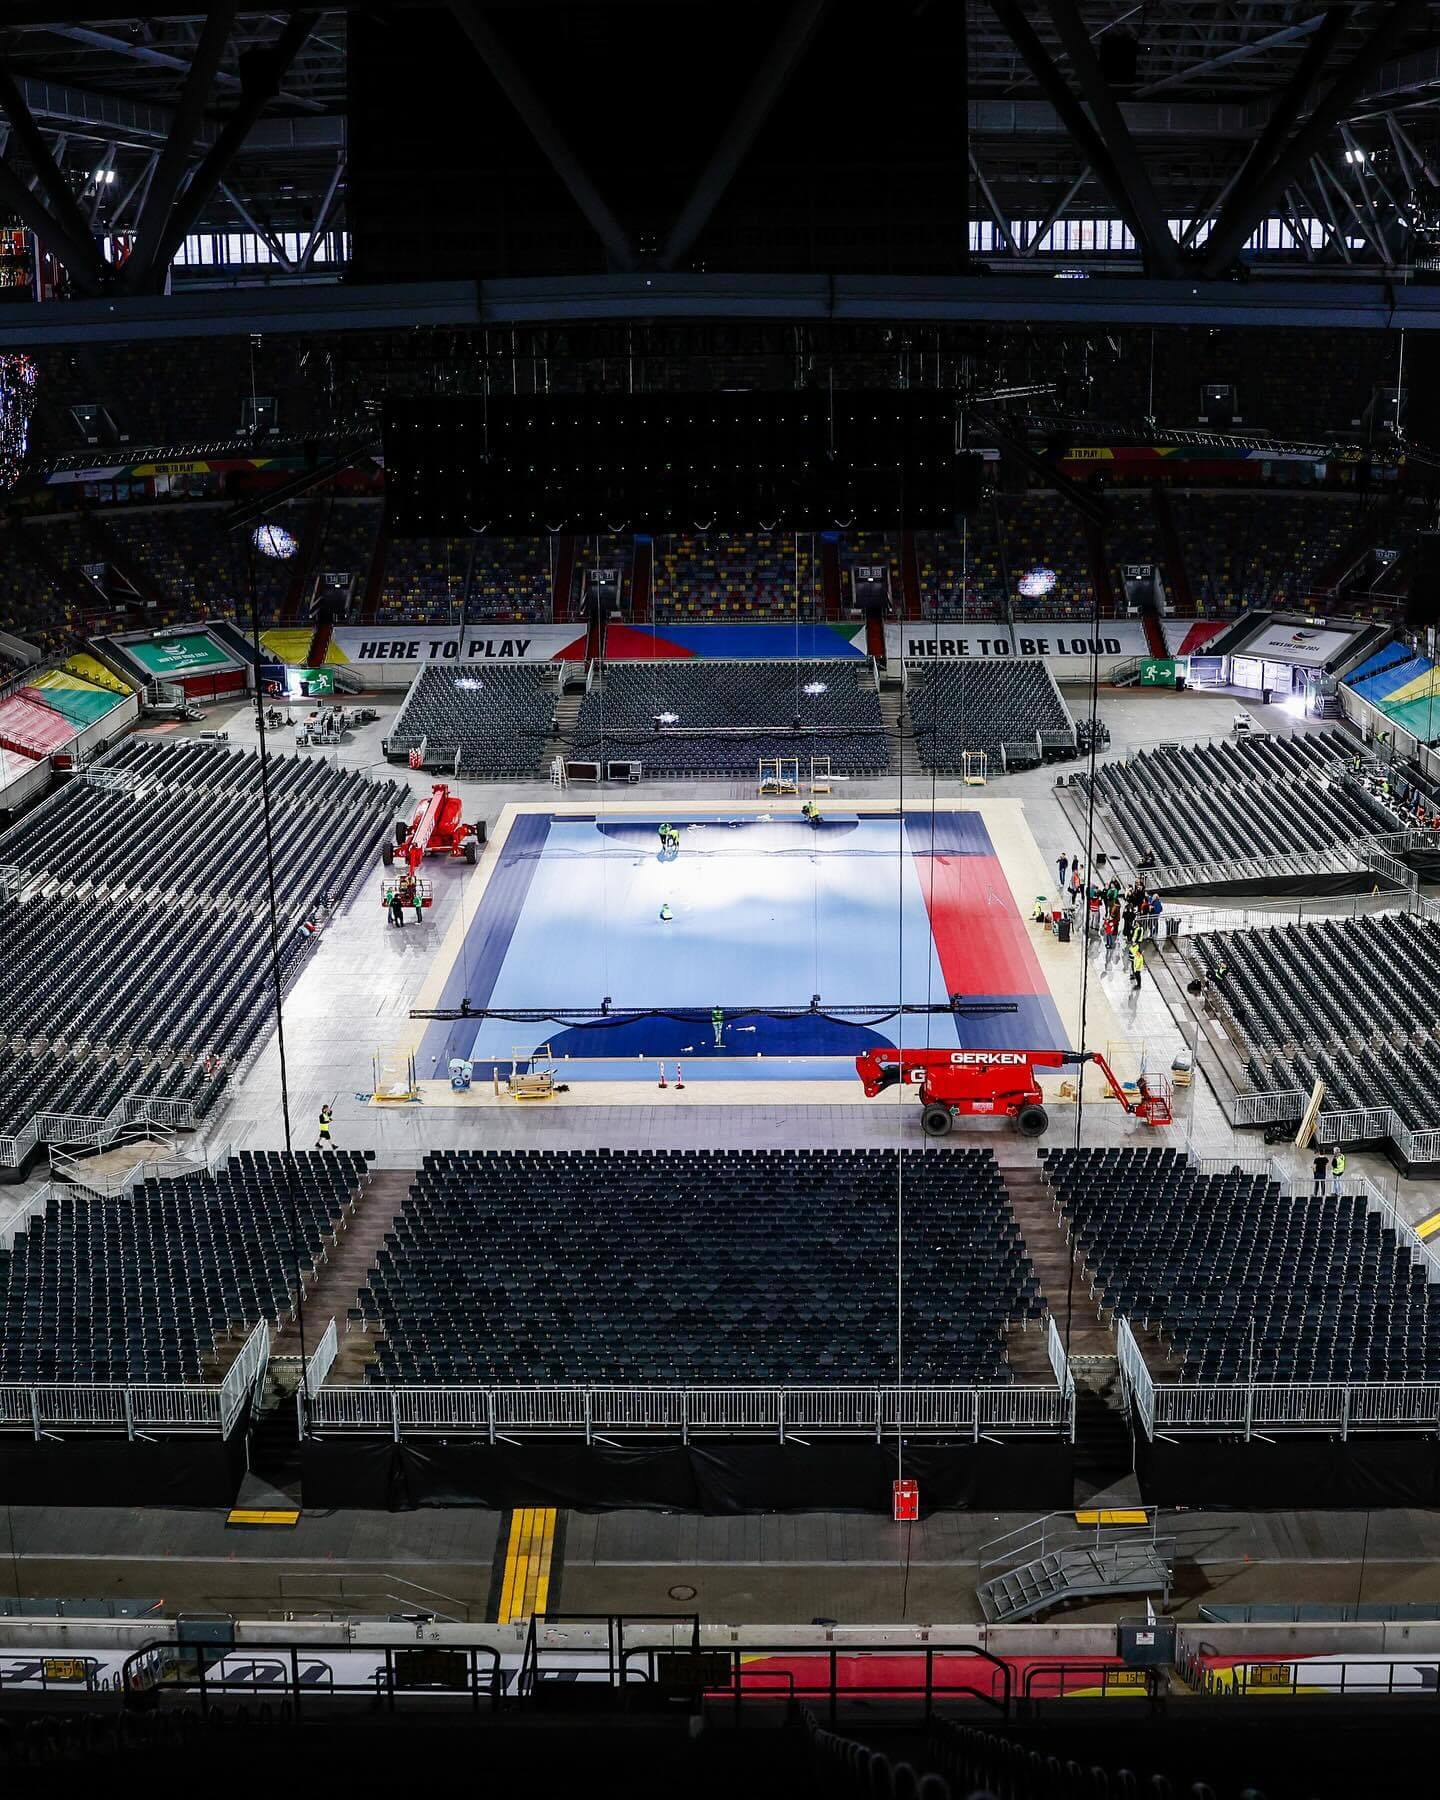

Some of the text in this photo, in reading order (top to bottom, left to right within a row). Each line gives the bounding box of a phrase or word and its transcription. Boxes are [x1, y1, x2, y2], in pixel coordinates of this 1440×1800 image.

[179, 463, 194, 472] PLAY
[358, 639, 531, 659] HERE TO PLAY
[908, 638, 1122, 656] HERE TO BE LOUD
[951, 1052, 1027, 1064] GERKEN
